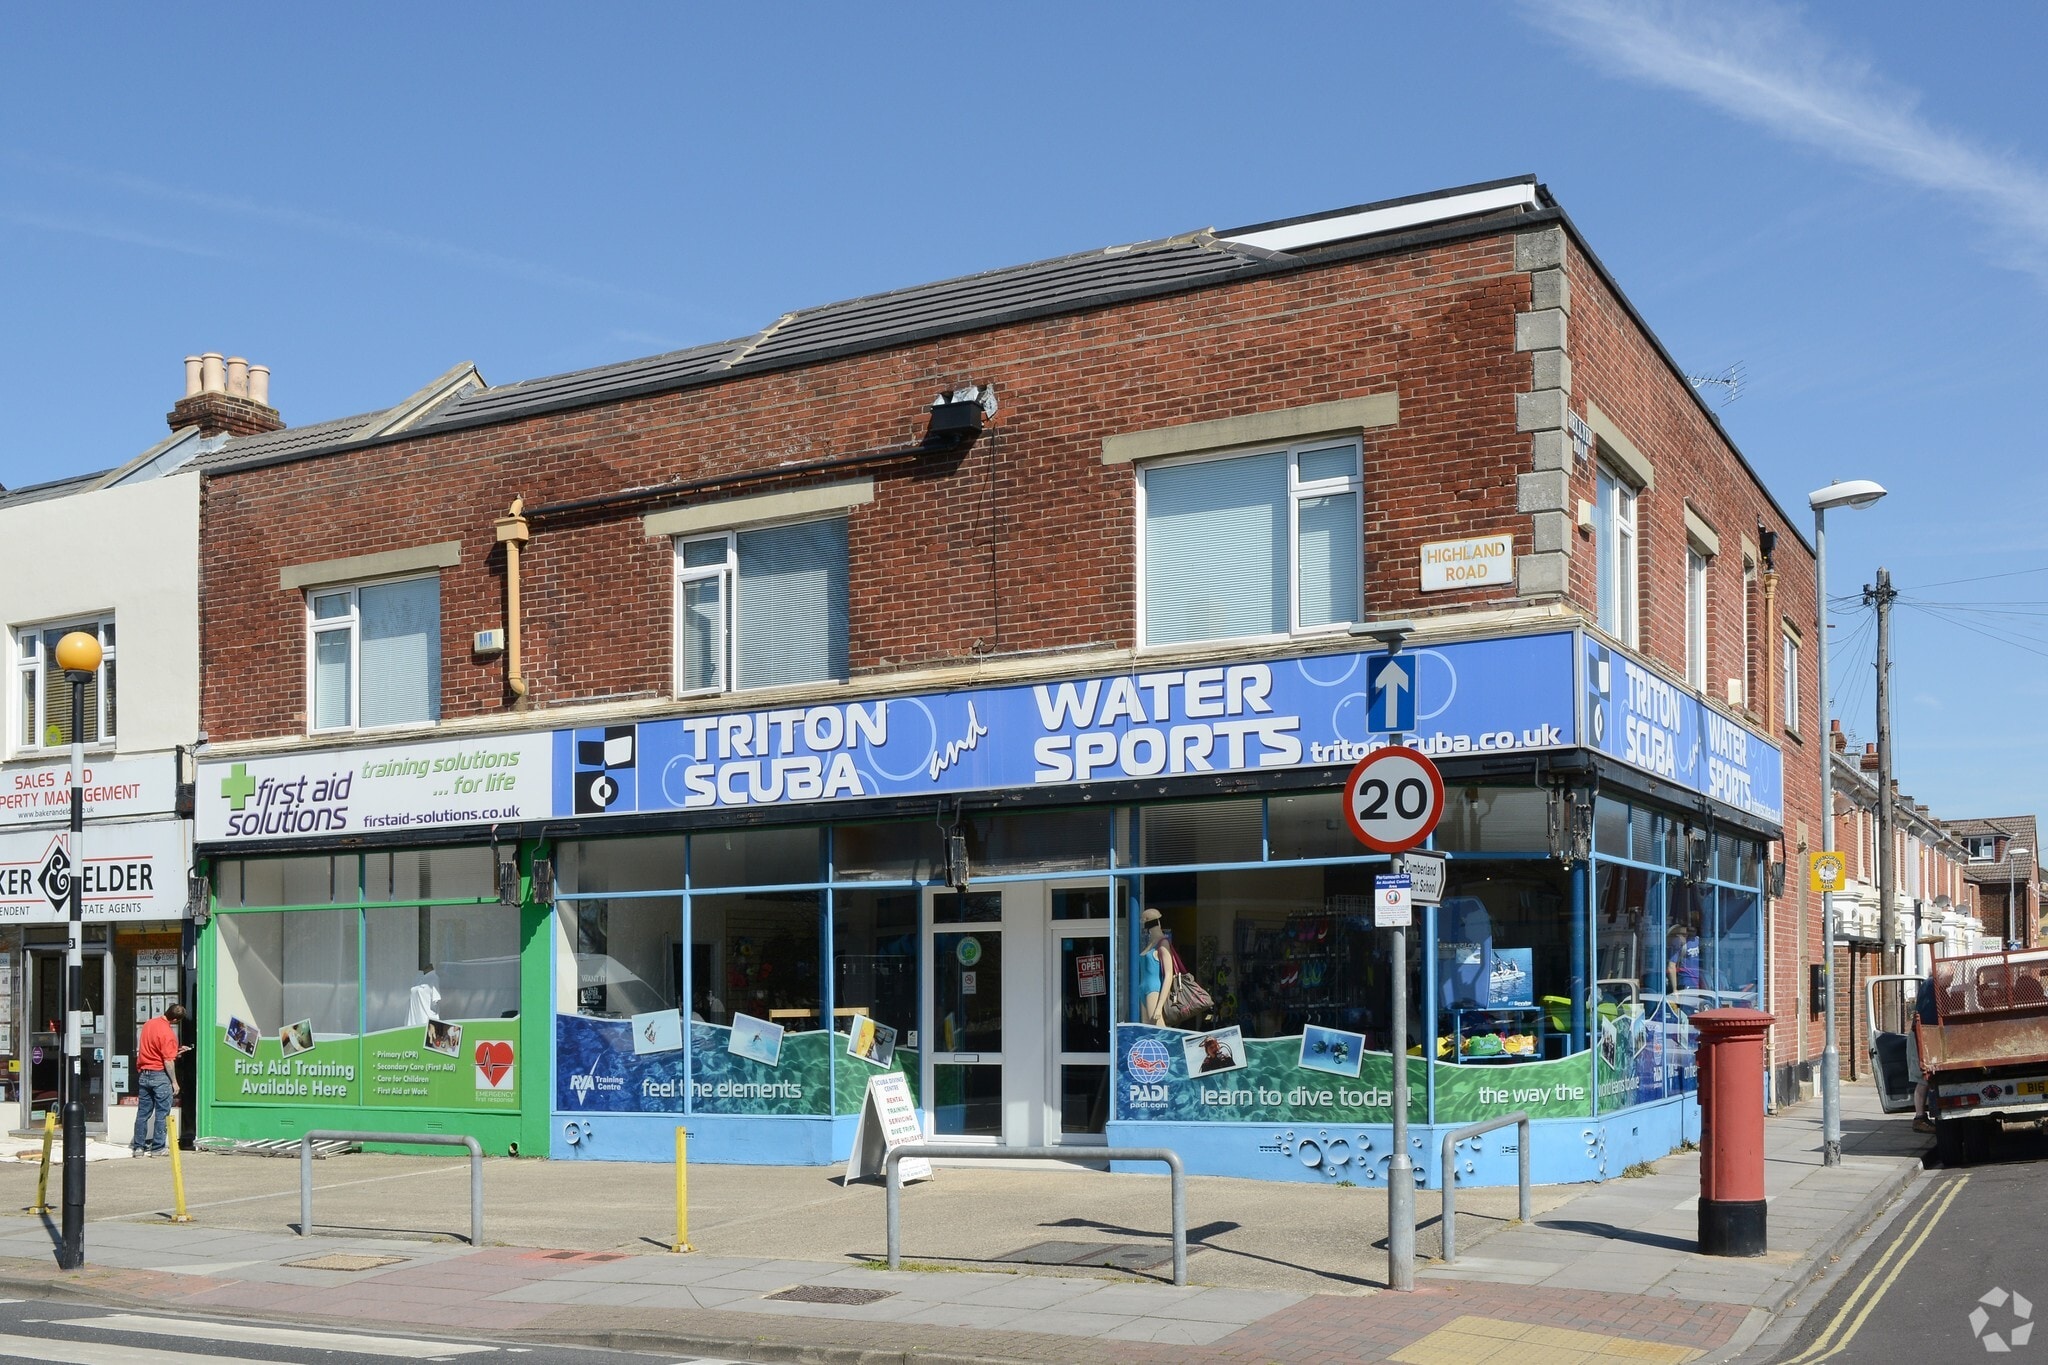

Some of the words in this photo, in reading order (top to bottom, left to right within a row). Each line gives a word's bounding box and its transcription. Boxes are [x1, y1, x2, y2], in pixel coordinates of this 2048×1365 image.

[1427, 542, 1505, 564] HIGHLAND
[1446, 563, 1488, 582] ROAD
[1032, 664, 1273, 731] WATER
[1625, 661, 1680, 734] TRITON
[684, 701, 888, 760] TRITON
[930, 700, 987, 781] and
[1707, 710, 1747, 768] WATER
[1034, 715, 1302, 783] SPORTS
[1626, 714, 1676, 779] SCUBA
[361, 758, 430, 779] training
[433, 751, 520, 772] solutions
[15, 772, 54, 790] SALES
[64, 769, 93, 785] AD
[256, 776, 307, 806] first
[311, 771, 353, 801] aid
[453, 776, 483, 795] for
[485, 773, 516, 791] life
[684, 753, 865, 807] SCUBA
[1709, 756, 1751, 810] SPORTS
[44, 783, 140, 806] MANGEMENT
[1359, 778, 1428, 820] 20
[225, 801, 348, 837] solutions
[363, 805, 521, 828] firstaid-solutions.co.uk
[83, 863, 153, 893] ELDER
[1405, 860, 1437, 876] Cumberland
[1420, 880, 1436, 893] School
[108, 903, 142, 913] AGENTS
[1081, 961, 1101, 971] OPEN
[377, 1051, 401, 1059] Primary
[402, 1051, 419, 1059] (CPR)
[235, 1059, 263, 1076] First
[267, 1060, 292, 1076] Aid
[295, 1060, 355, 1081] Training
[377, 1063, 408, 1071] Secondary
[241, 1080, 307, 1096] Available
[312, 1081, 347, 1097] Here
[403, 1075, 429, 1083] Children
[570, 1075, 595, 1090] RYA
[595, 1075, 624, 1085] Training
[642, 1078, 674, 1097] feel
[718, 1079, 801, 1098] elements
[1129, 1085, 1168, 1101] PADI
[1200, 1088, 1253, 1106] learn
[1258, 1086, 1282, 1106] to
[1287, 1087, 1333, 1106] dive
[1479, 1087, 1509, 1104] the
[1512, 1088, 1551, 1106] way
[1555, 1083, 1584, 1100] the
[887, 1106, 909, 1114] TRAINING
[889, 1116, 913, 1125] SERVICING
[889, 1138, 901, 1146] DIVE
[902, 1134, 923, 1143] HOLIDAYS
[902, 1125, 916, 1133] TRIPS
